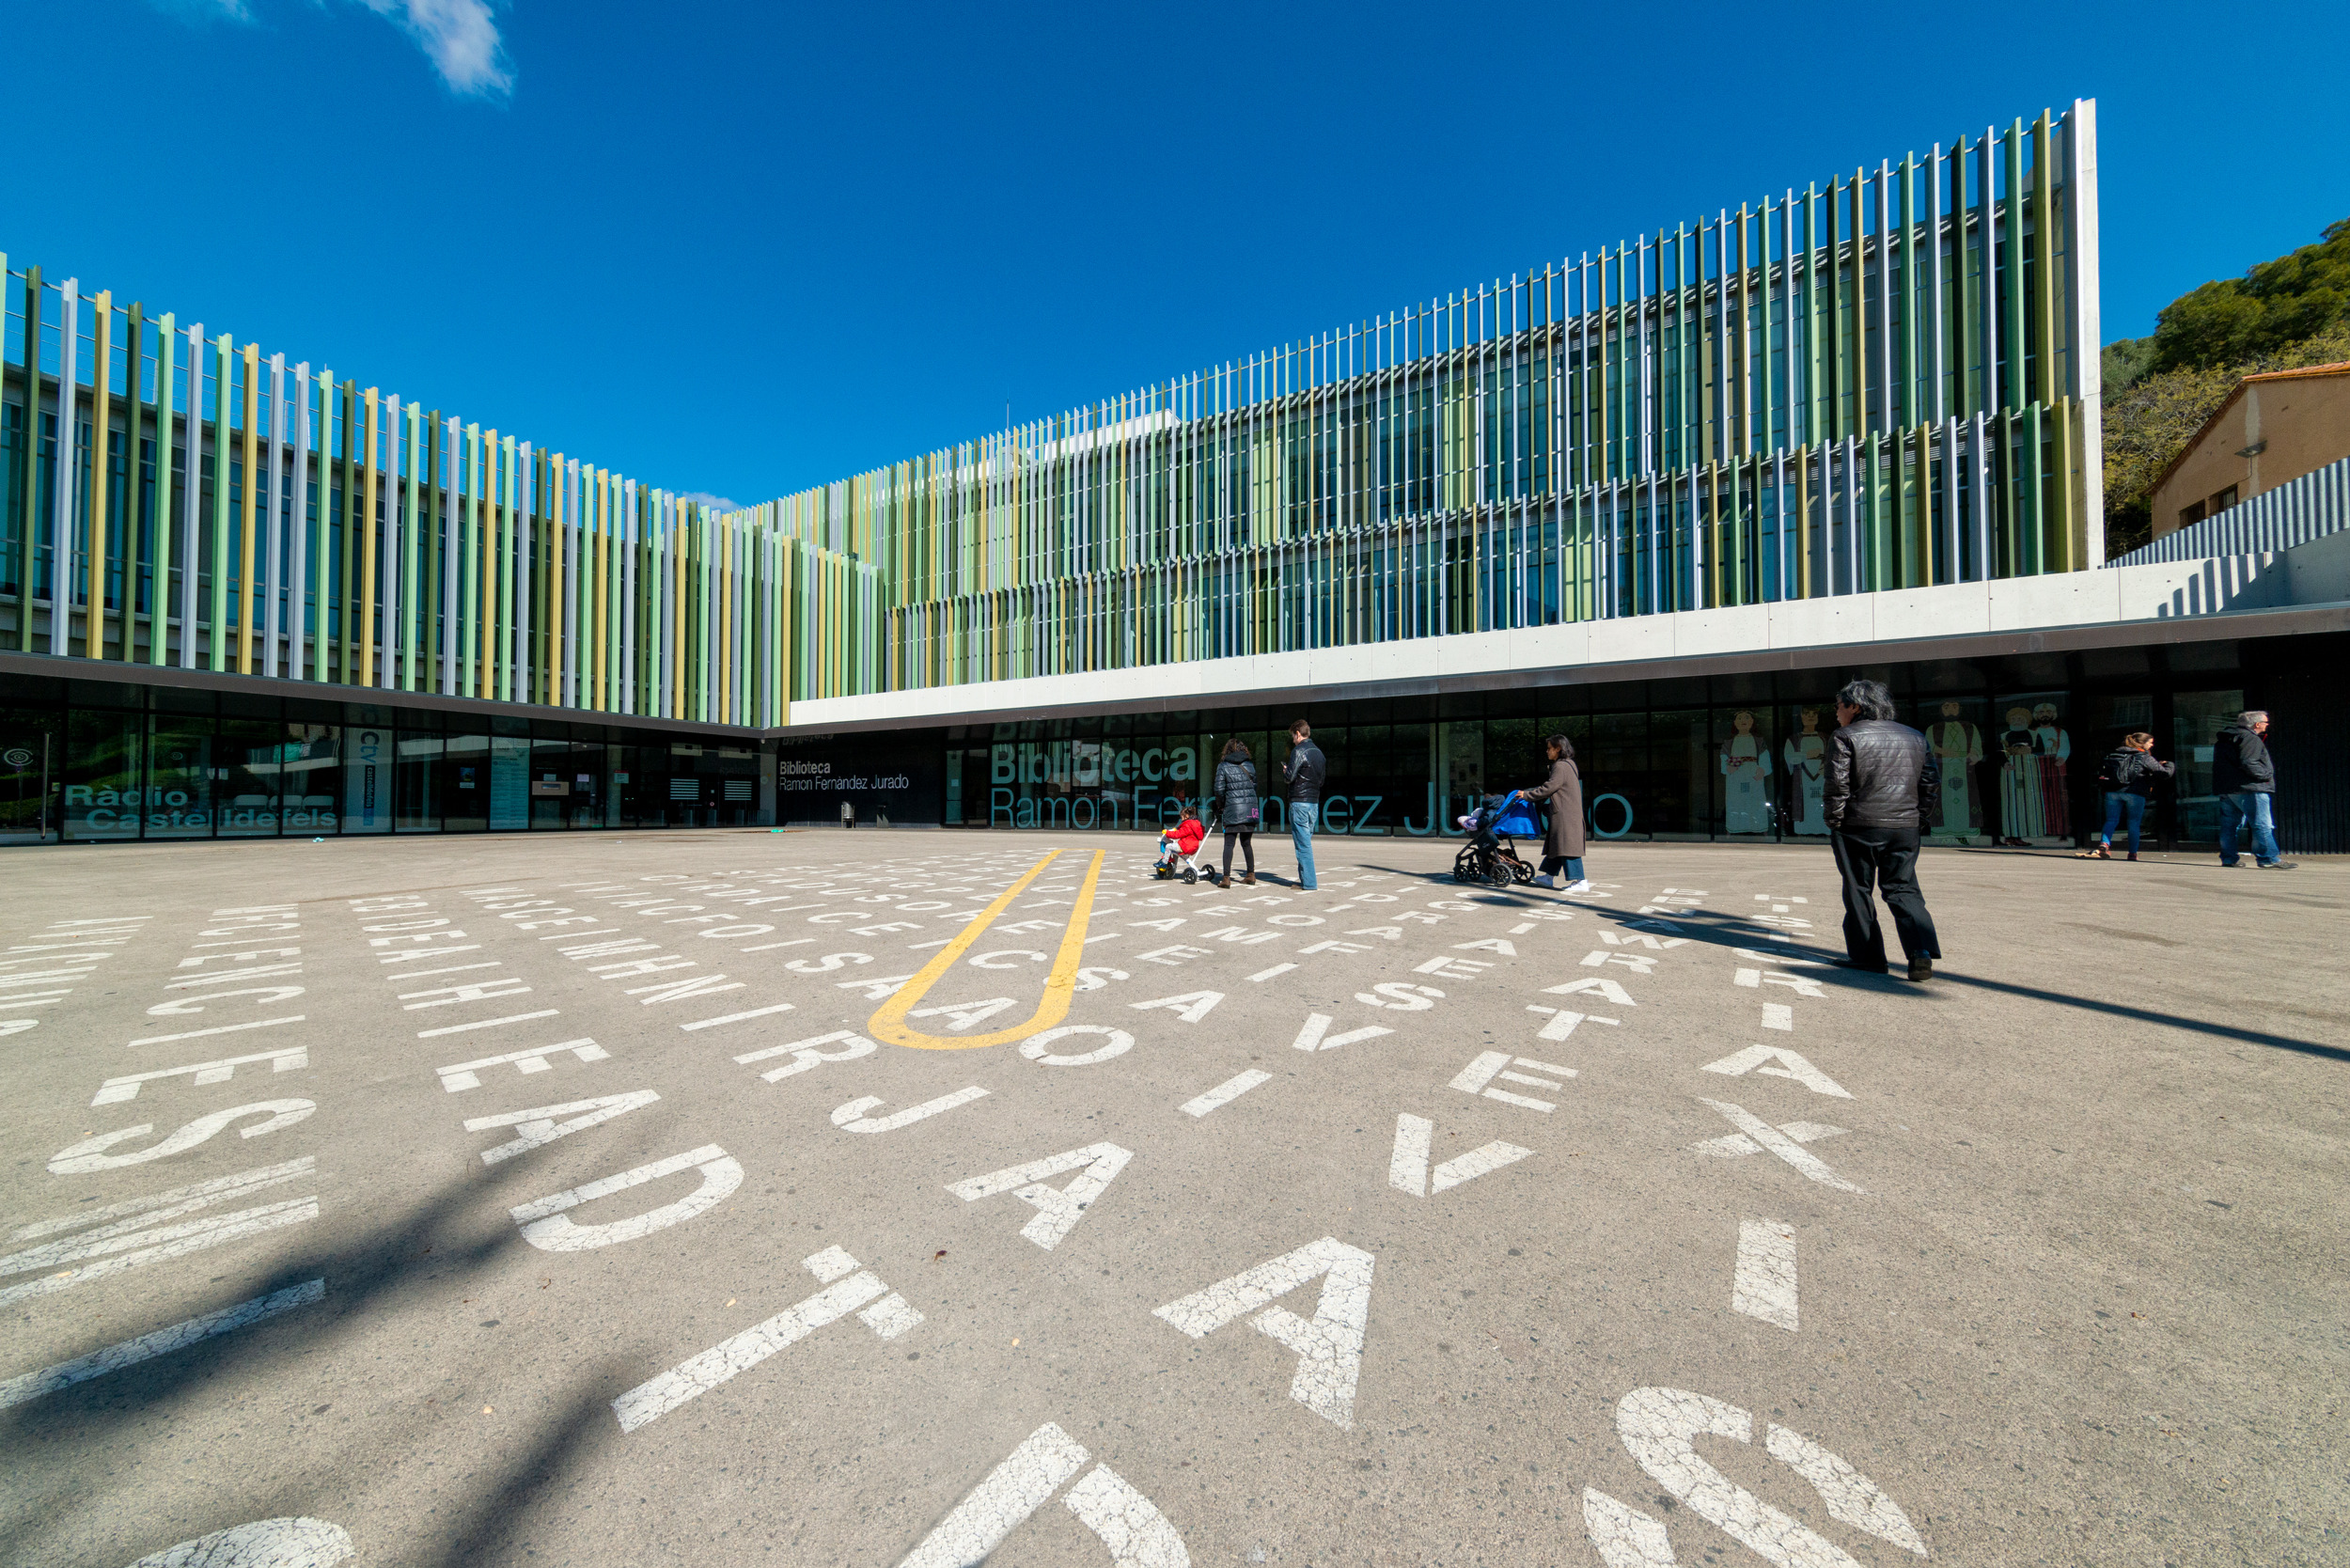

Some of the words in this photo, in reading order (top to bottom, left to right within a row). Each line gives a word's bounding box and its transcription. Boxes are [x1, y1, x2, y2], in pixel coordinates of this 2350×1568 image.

[779, 760, 831, 776] Biblioteca
[779, 777, 813, 791] Ramon
[815, 775, 869, 791] Fernàndez
[871, 773, 909, 790] Jurado
[991, 741, 1197, 785] Biblioteca
[65, 784, 188, 807] Ràdio
[86, 808, 337, 831] Castelldefels
[991, 788, 1119, 829] Ramon
[164, 962, 303, 989] N
[587, 955, 698, 980] H
[624, 974, 747, 1005] N
[1579, 950, 1658, 974] R
[1733, 967, 1829, 998] R
[147, 986, 306, 1015] C
[398, 978, 532, 1010] H
[680, 1003, 795, 1031] I
[1412, 956, 1496, 980] E
[1540, 978, 1637, 1006] A
[1761, 1002, 1793, 1032] I
[127, 1015, 306, 1047] I
[417, 1009, 559, 1038] I
[1355, 982, 1445, 1011] S
[1526, 1005, 1620, 1042] T
[1700, 1044, 1856, 1100] A
[90, 1045, 308, 1106] E
[436, 1038, 611, 1092] E
[732, 1030, 877, 1084] R
[831, 1086, 991, 1134] J
[1128, 990, 1225, 1023] A
[1292, 1012, 1396, 1052] V
[1448, 1050, 1578, 1113] E
[1691, 1097, 1872, 1197] X
[47, 1098, 317, 1175] S
[462, 1090, 662, 1164] A
[834, 974, 915, 1000] A
[908, 997, 1018, 1031] A
[1019, 1025, 1135, 1065] O
[1178, 1069, 1273, 1118] I
[1388, 1112, 1536, 1198] V
[1724, 1215, 1803, 1333] I
[509, 1143, 745, 1252] D
[943, 1141, 1135, 1251] A
[0, 1155, 319, 1309] M
[0, 1278, 325, 1410] I
[611, 1244, 924, 1433] T
[1151, 1236, 1375, 1431] A
